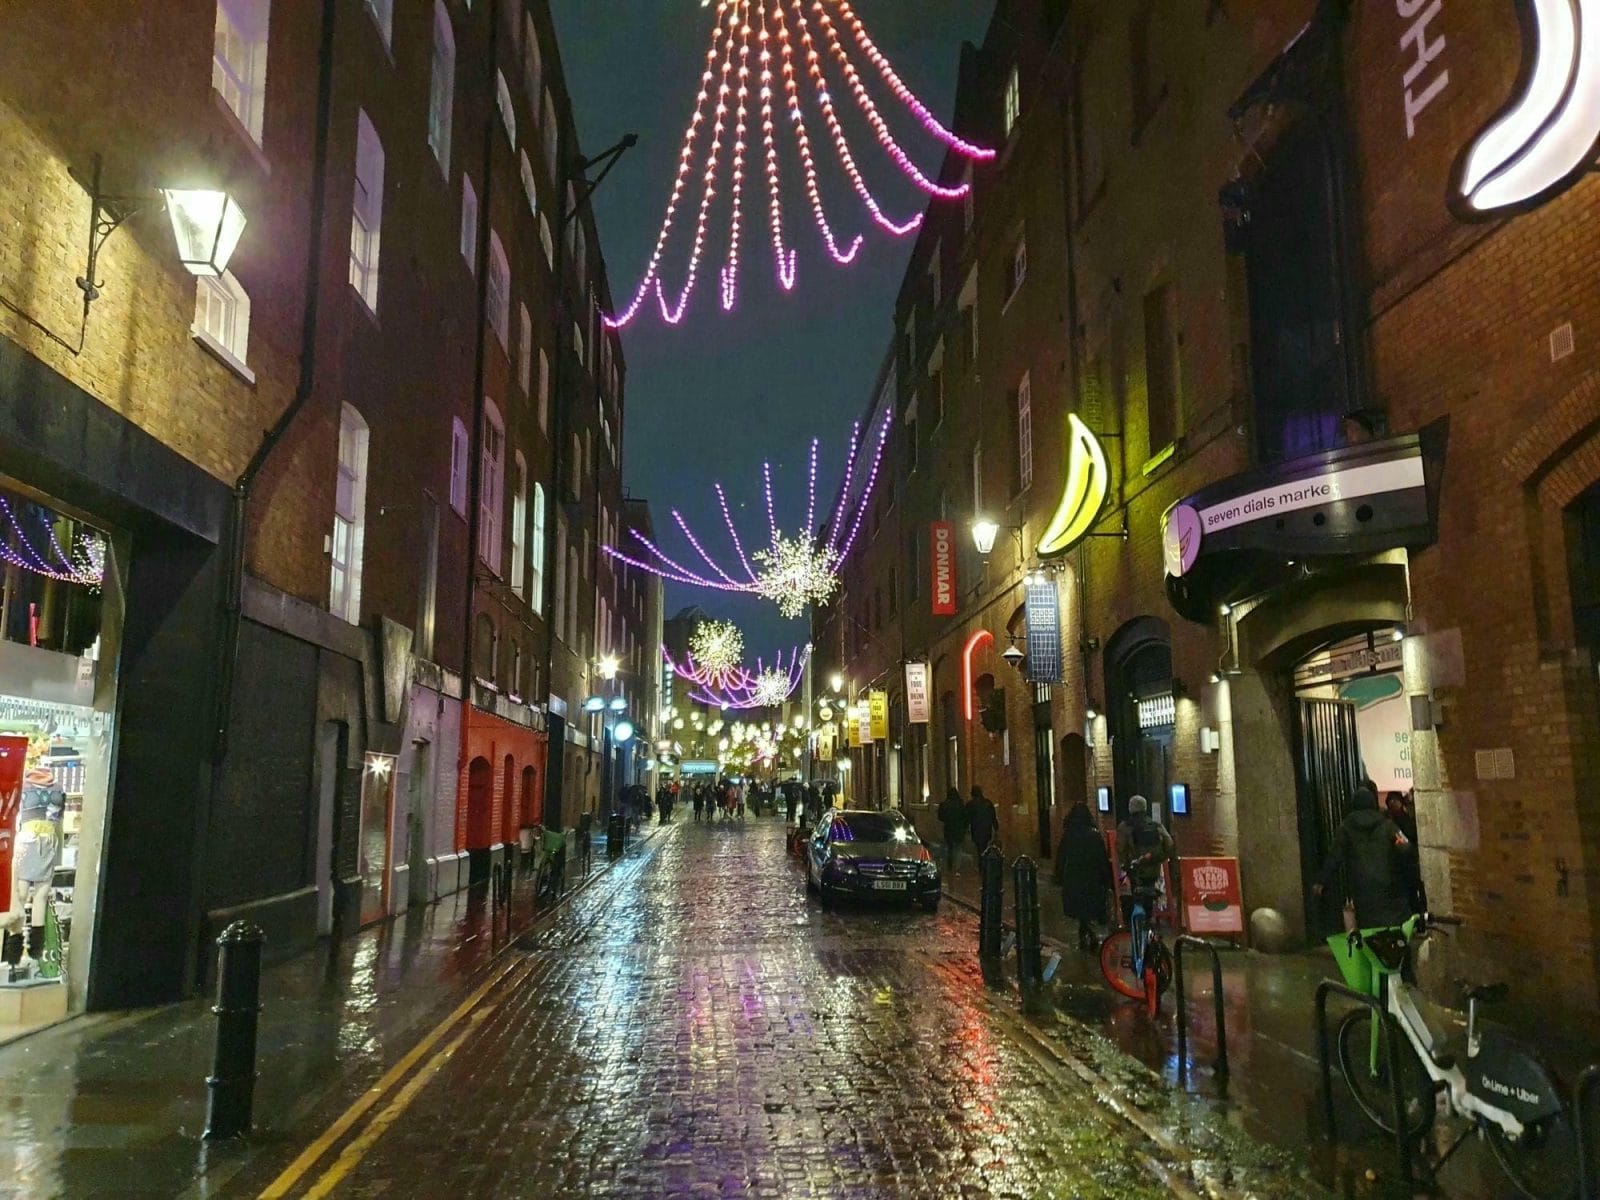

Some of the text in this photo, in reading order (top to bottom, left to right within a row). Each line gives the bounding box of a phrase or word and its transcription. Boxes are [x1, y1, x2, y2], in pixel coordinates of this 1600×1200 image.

[1208, 483, 1339, 526] seven dials marke
[936, 528, 950, 605] DONMAR
[1516, 1087, 1539, 1104] Uber
